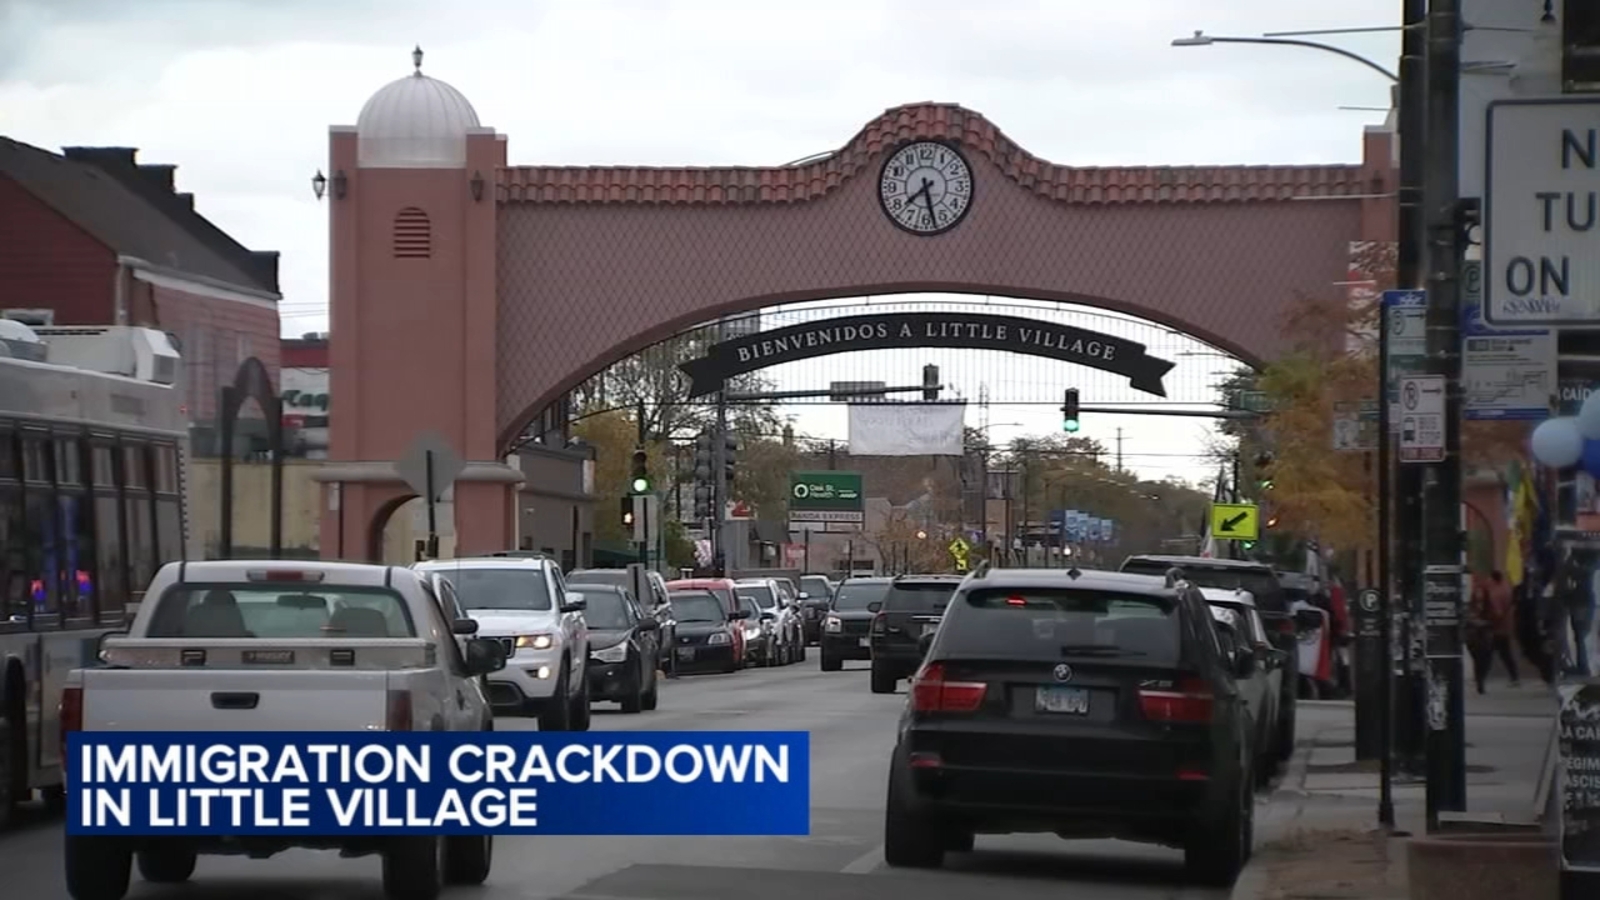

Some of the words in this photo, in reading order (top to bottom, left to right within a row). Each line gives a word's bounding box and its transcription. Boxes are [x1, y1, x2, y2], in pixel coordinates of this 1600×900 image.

[905, 153, 915, 165] 11
[920, 149, 933, 160] 12
[940, 152, 945, 164] 1
[893, 166, 905, 177] 10
[949, 163, 959, 175] 2
[887, 181, 897, 193] 9
[954, 180, 964, 192] 3
[893, 198, 902, 210] 8
[949, 198, 958, 209] 4
[906, 209, 916, 221] 7
[921, 213, 931, 226] 6
[938, 209, 947, 221] 5
[1506, 256, 1570, 296] ON
[737, 323, 888, 362] BIENVENIDOS
[899, 322, 913, 337] A
[925, 322, 1008, 340] LITTLE
[1018, 328, 1116, 360] VILLAGE
[790, 512, 820, 520] PANDA
[823, 512, 861, 520] EXPRESS
